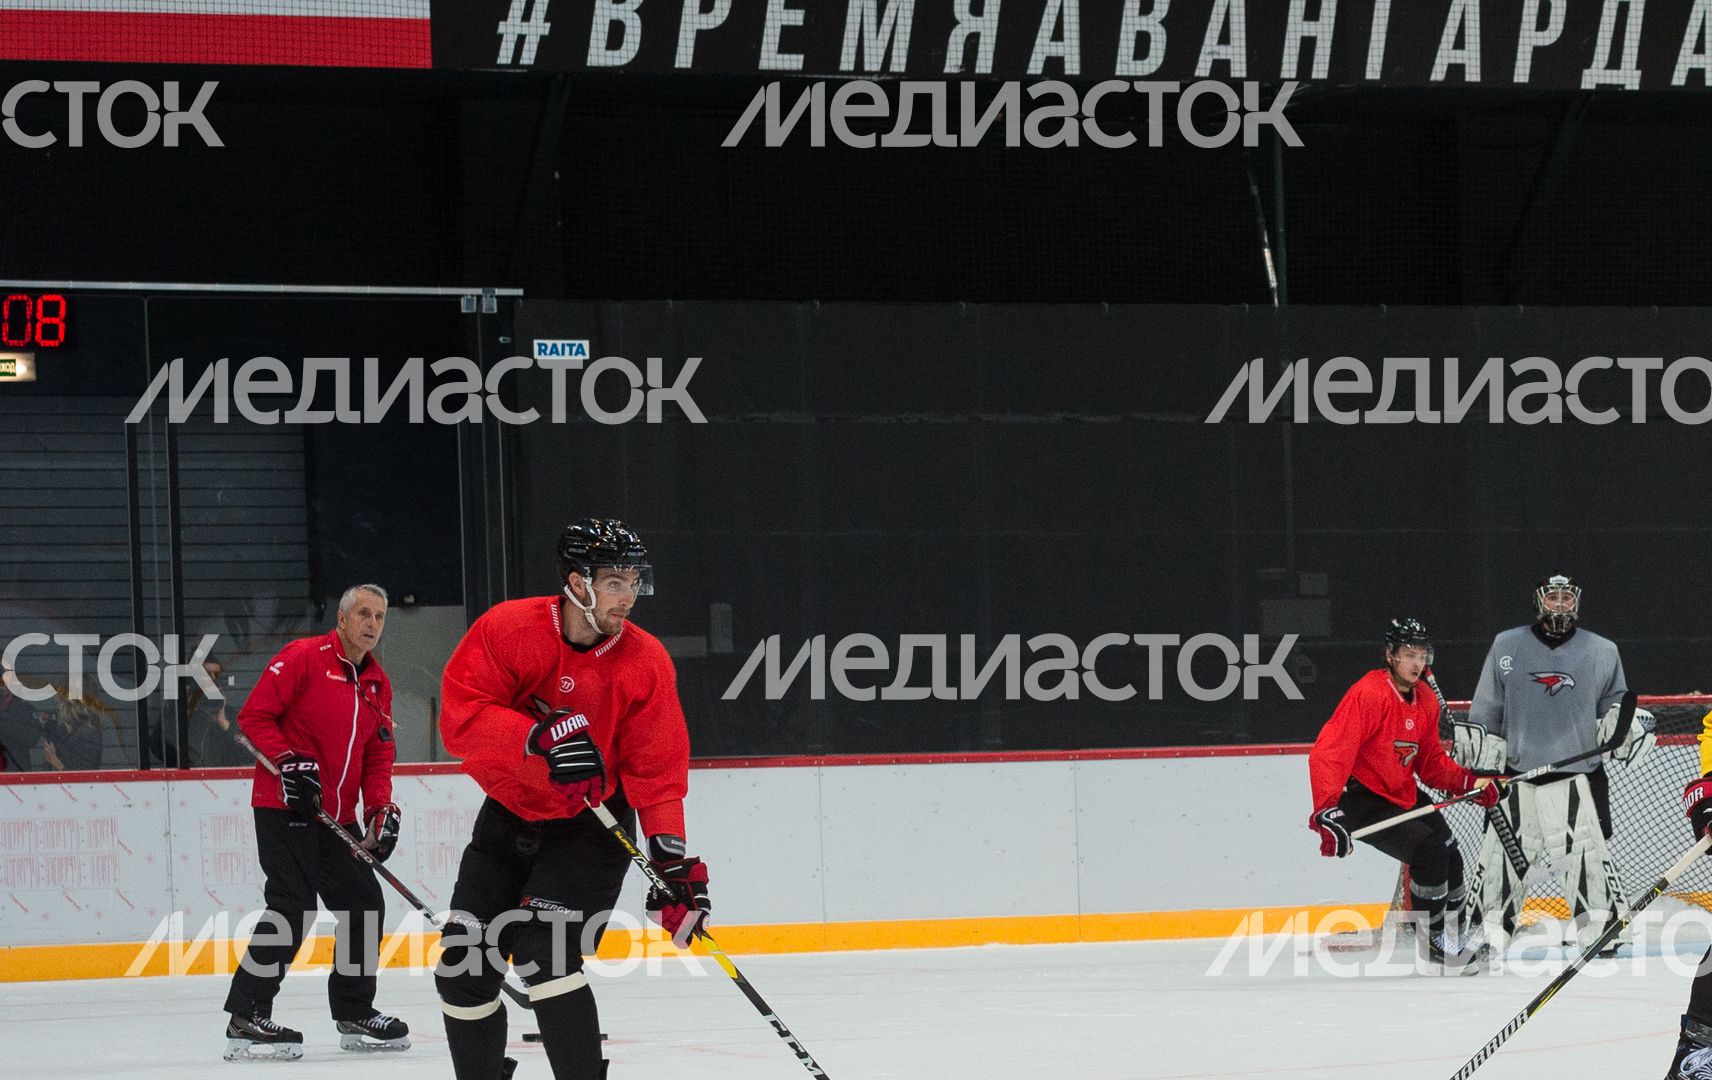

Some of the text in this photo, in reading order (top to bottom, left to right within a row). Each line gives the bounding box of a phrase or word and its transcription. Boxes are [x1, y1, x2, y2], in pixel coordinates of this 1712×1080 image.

[2, 293, 66, 347] 08
[537, 342, 586, 356] RAITA
[1487, 805, 1528, 873] ARRIOR
[632, 853, 667, 890] TACKS
[1467, 862, 1485, 909] CCM
[1603, 860, 1625, 904] CCM
[763, 1010, 826, 1077] CCM
